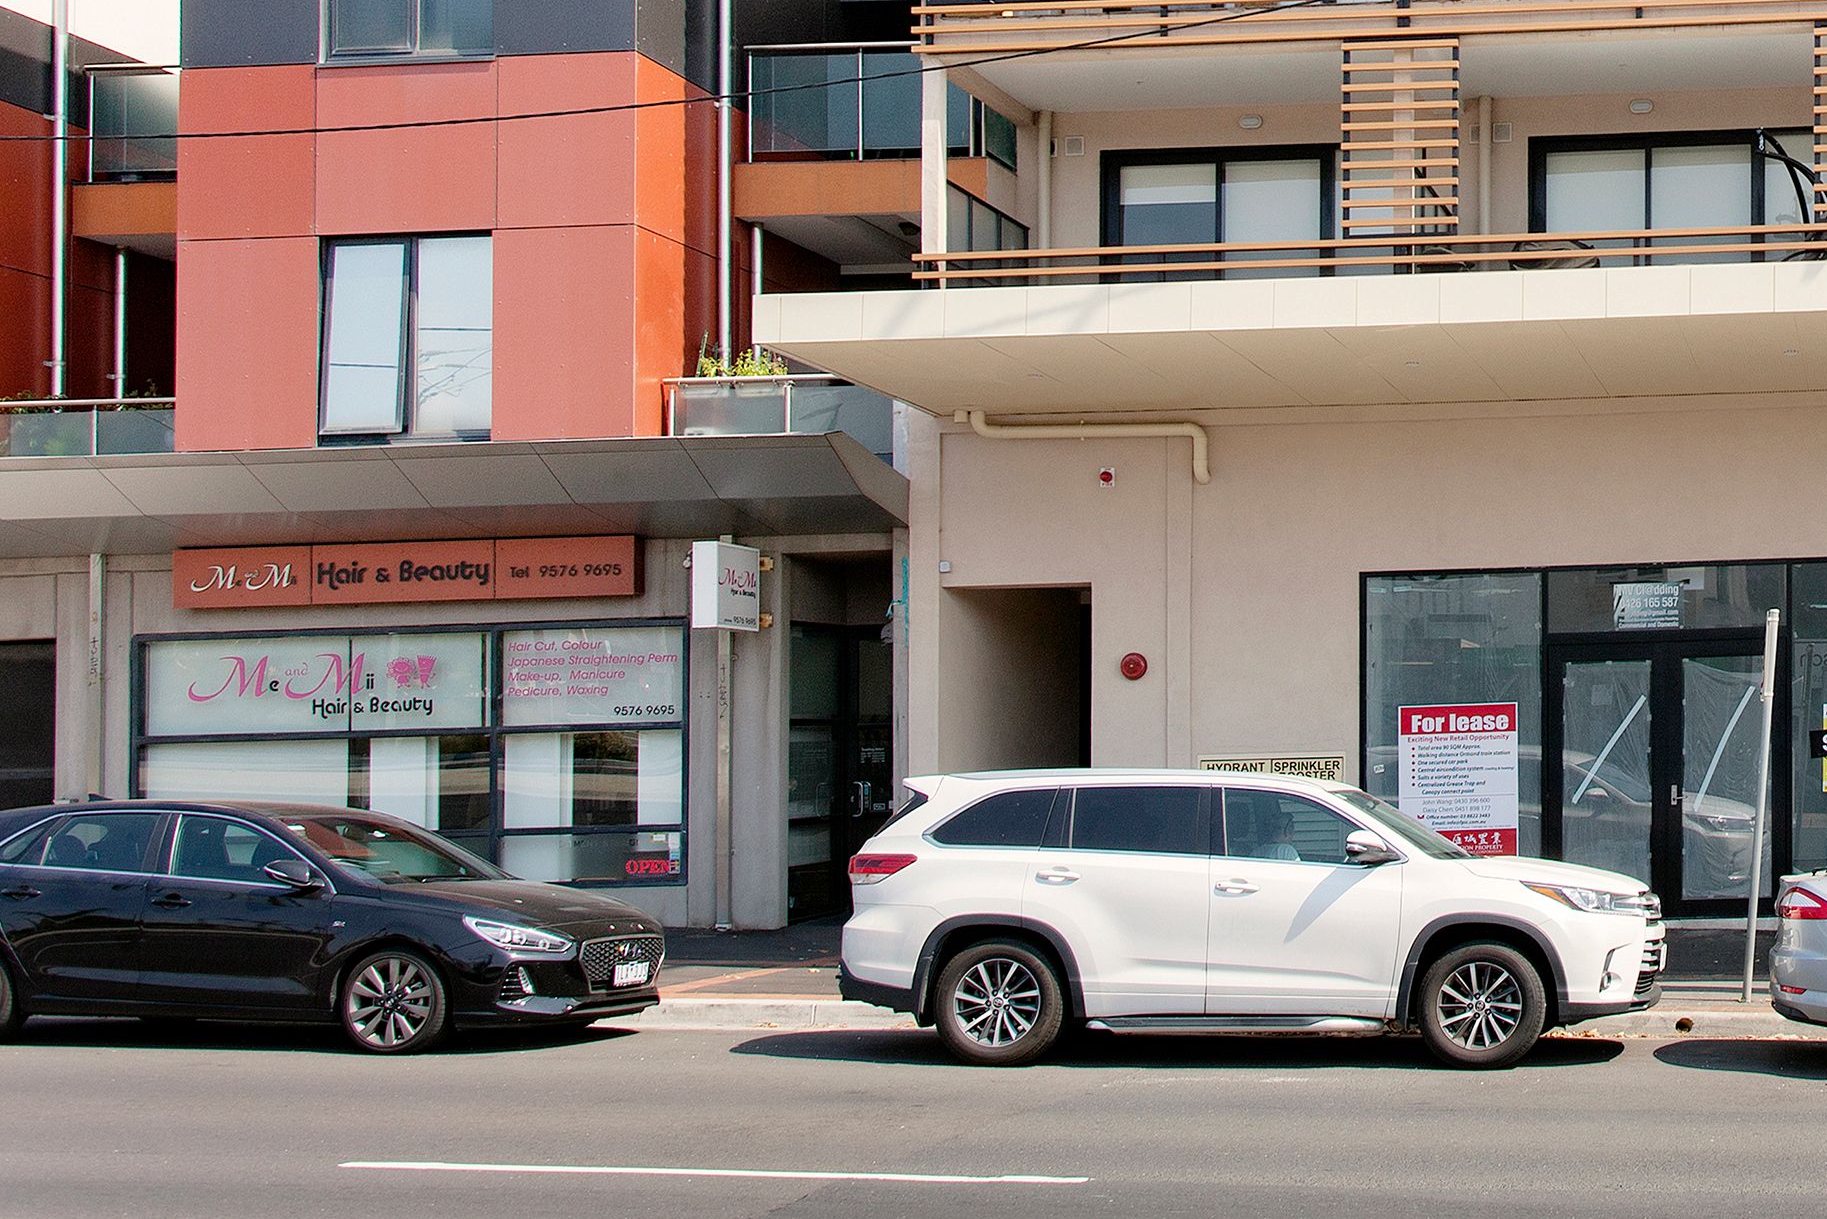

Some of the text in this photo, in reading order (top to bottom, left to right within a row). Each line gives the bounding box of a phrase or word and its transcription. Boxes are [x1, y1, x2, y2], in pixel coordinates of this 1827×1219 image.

[316, 559, 490, 590] Hair & Beauty
[510, 563, 622, 578] Tel 9576 9695
[1643, 597, 1660, 608] 165
[507, 640, 604, 652] Hair Cut, Colour
[507, 652, 678, 668] Japanese Straightening Perm
[507, 669, 626, 683] Make-up, Manicure
[507, 684, 609, 697] Pedicure, Waxing
[312, 697, 433, 719] Hair & Beauty
[613, 704, 675, 716] 9576 9695
[1411, 713, 1510, 734] For lease
[1407, 736, 1433, 744] Exciting
[1449, 734, 1468, 742] Retail
[1469, 733, 1510, 742] Opportunity
[1273, 760, 1341, 772] SPRINKLER
[1279, 770, 1336, 780] STER
[625, 860, 670, 874] OPEN
